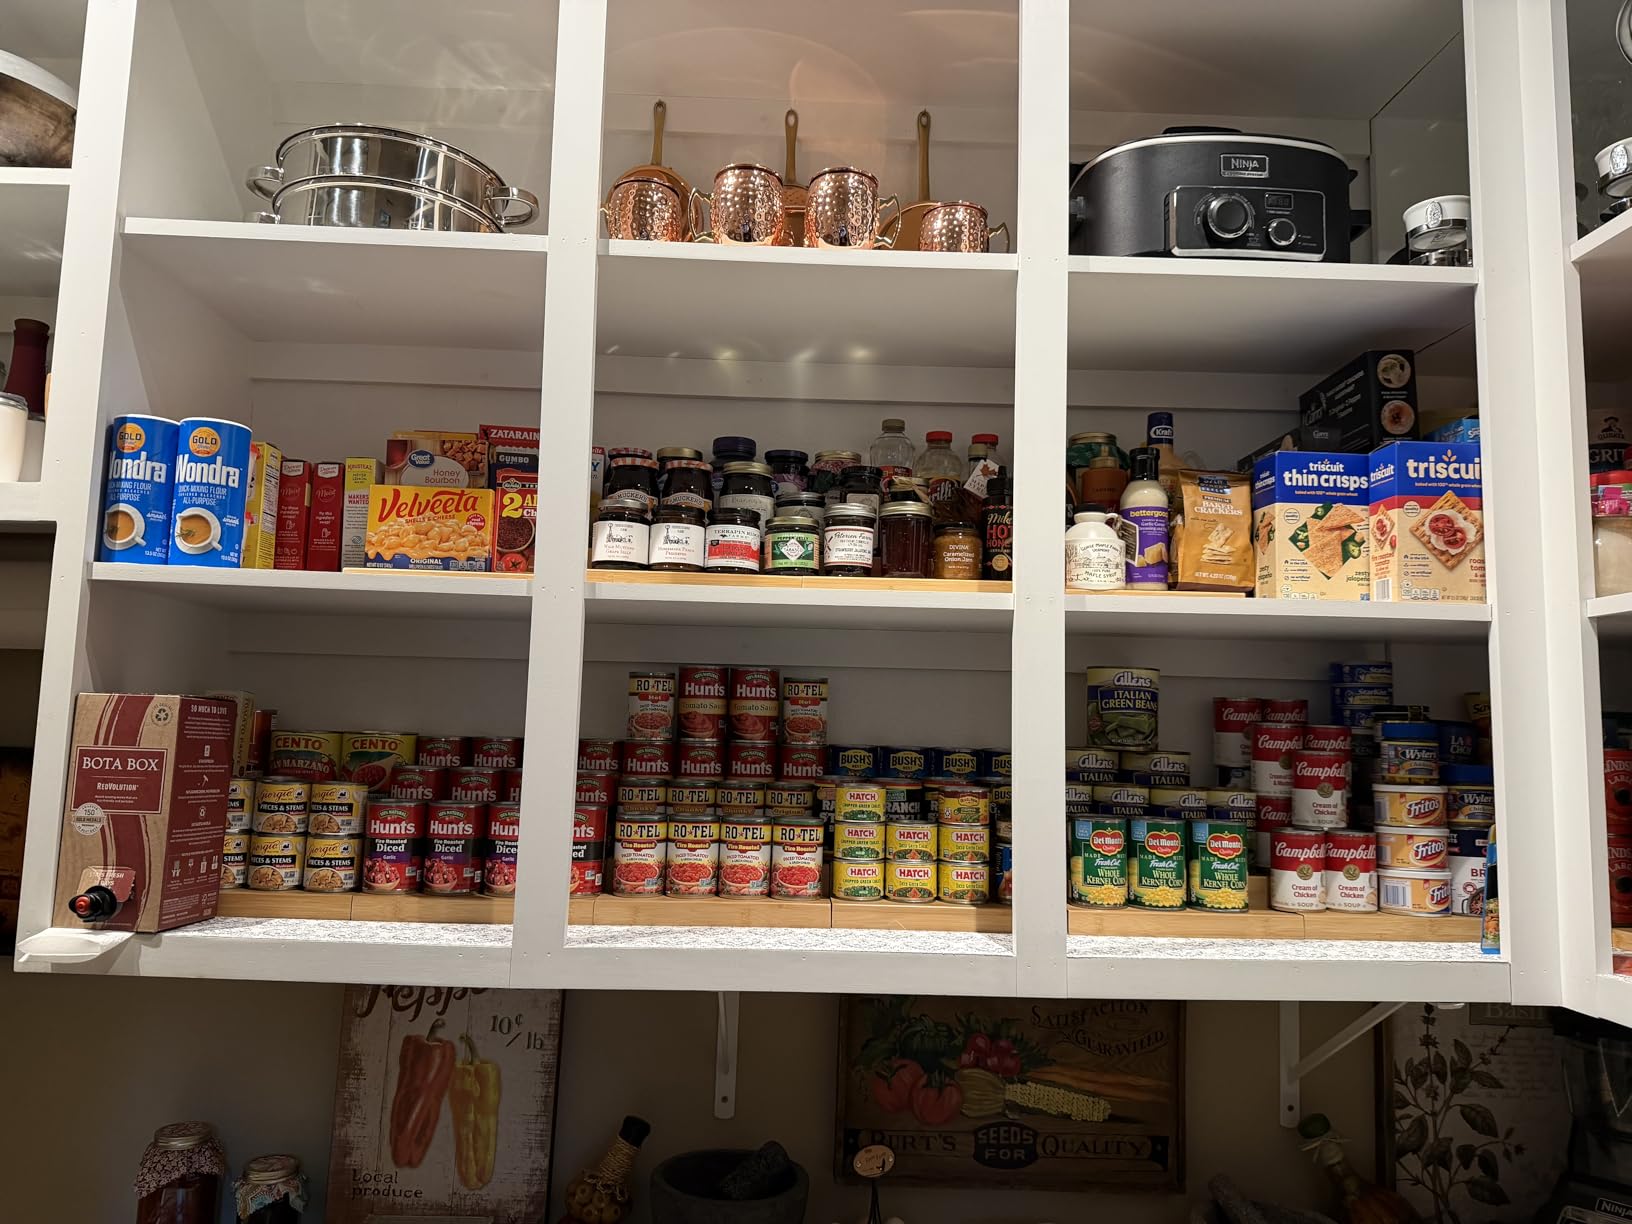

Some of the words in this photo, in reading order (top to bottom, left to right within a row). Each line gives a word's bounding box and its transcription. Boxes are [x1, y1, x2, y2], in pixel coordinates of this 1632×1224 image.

[1231, 158, 1259, 171] NINJA
[119, 432, 142, 440] GOLD
[1155, 428, 1173, 437] Kraft
[192, 435, 217, 445] GOLD
[411, 453, 431, 463] Great
[498, 455, 529, 463] GUMBO
[175, 453, 239, 488] Wondra
[1308, 461, 1345, 473] triscuit
[1406, 456, 1480, 480] triscui
[433, 469, 461, 478] Honey
[1370, 464, 1395, 482] triscuit
[424, 476, 461, 484] Bourbon
[1283, 469, 1320, 487] thin
[1320, 474, 1369, 491] crisps
[209, 486, 227, 495] FLOUR
[183, 496, 216, 506] ALL-PURPOSE
[378, 487, 480, 522] Velveeta
[502, 492, 523, 518] 2
[1202, 500, 1234, 510] BAKED
[1194, 507, 1243, 516] CRACKERS
[1114, 690, 1152, 700] ITALIAN
[1102, 699, 1133, 709] GREEN
[1135, 700, 1157, 711] BEANS
[275, 736, 322, 750] CENTO
[352, 738, 398, 751] CENTO
[1449, 736, 1464, 746] LA
[82, 756, 123, 770] BOTA
[127, 758, 160, 772] BOX
[840, 753, 872, 766] BUSH'S
[891, 754, 923, 767] BUSH'S
[944, 757, 976, 769] BUSH'S
[281, 758, 330, 774] MARZANO
[1079, 772, 1114, 782] ITALIAN
[1150, 775, 1185, 785] ITALIAN
[849, 792, 876, 801] HATCH
[994, 790, 1012, 800] BUS
[886, 801, 921, 814] RANCH
[1311, 801, 1331, 809] Cream
[1407, 798, 1440, 818] Fritos
[1113, 806, 1144, 815] ITALIAN
[1313, 808, 1337, 816] Chicken
[847, 829, 874, 837] HATCH
[898, 831, 929, 840] HATCH
[955, 833, 985, 842] HATCH
[1093, 836, 1105, 844] Del
[1105, 837, 1123, 845] Monte
[1148, 837, 1160, 846] Del
[1160, 838, 1180, 847] Monte
[1210, 839, 1222, 848] Del
[1222, 840, 1243, 849] Monte
[376, 843, 405, 853] Diced
[434, 844, 463, 853] Diced
[1415, 841, 1445, 859] Fritos
[850, 868, 877, 877] HATCH
[899, 869, 930, 878] HATCH
[955, 871, 985, 880] HATCH
[1097, 868, 1120, 877] WHOLE
[1152, 870, 1177, 879] WHOLE
[1214, 872, 1239, 881] WHOLE
[1087, 875, 1112, 886] KERNEL
[1112, 876, 1126, 886] CORN
[1141, 876, 1167, 887] KERNEL
[1167, 878, 1184, 887] CORN
[1203, 878, 1230, 888] KERNEL
[1230, 880, 1246, 889] CORN
[1031, 1000, 1148, 1028] SATISFACTION
[1074, 1028, 1165, 1056] GUARANTEED
[975, 1127, 1034, 1146] SEEDS
[871, 1131, 956, 1154] BURT'S
[1041, 1135, 1144, 1157] QUALITY
[983, 1148, 1026, 1161] FOR
[352, 1168, 399, 1184] Local
[352, 1185, 424, 1200] produce
